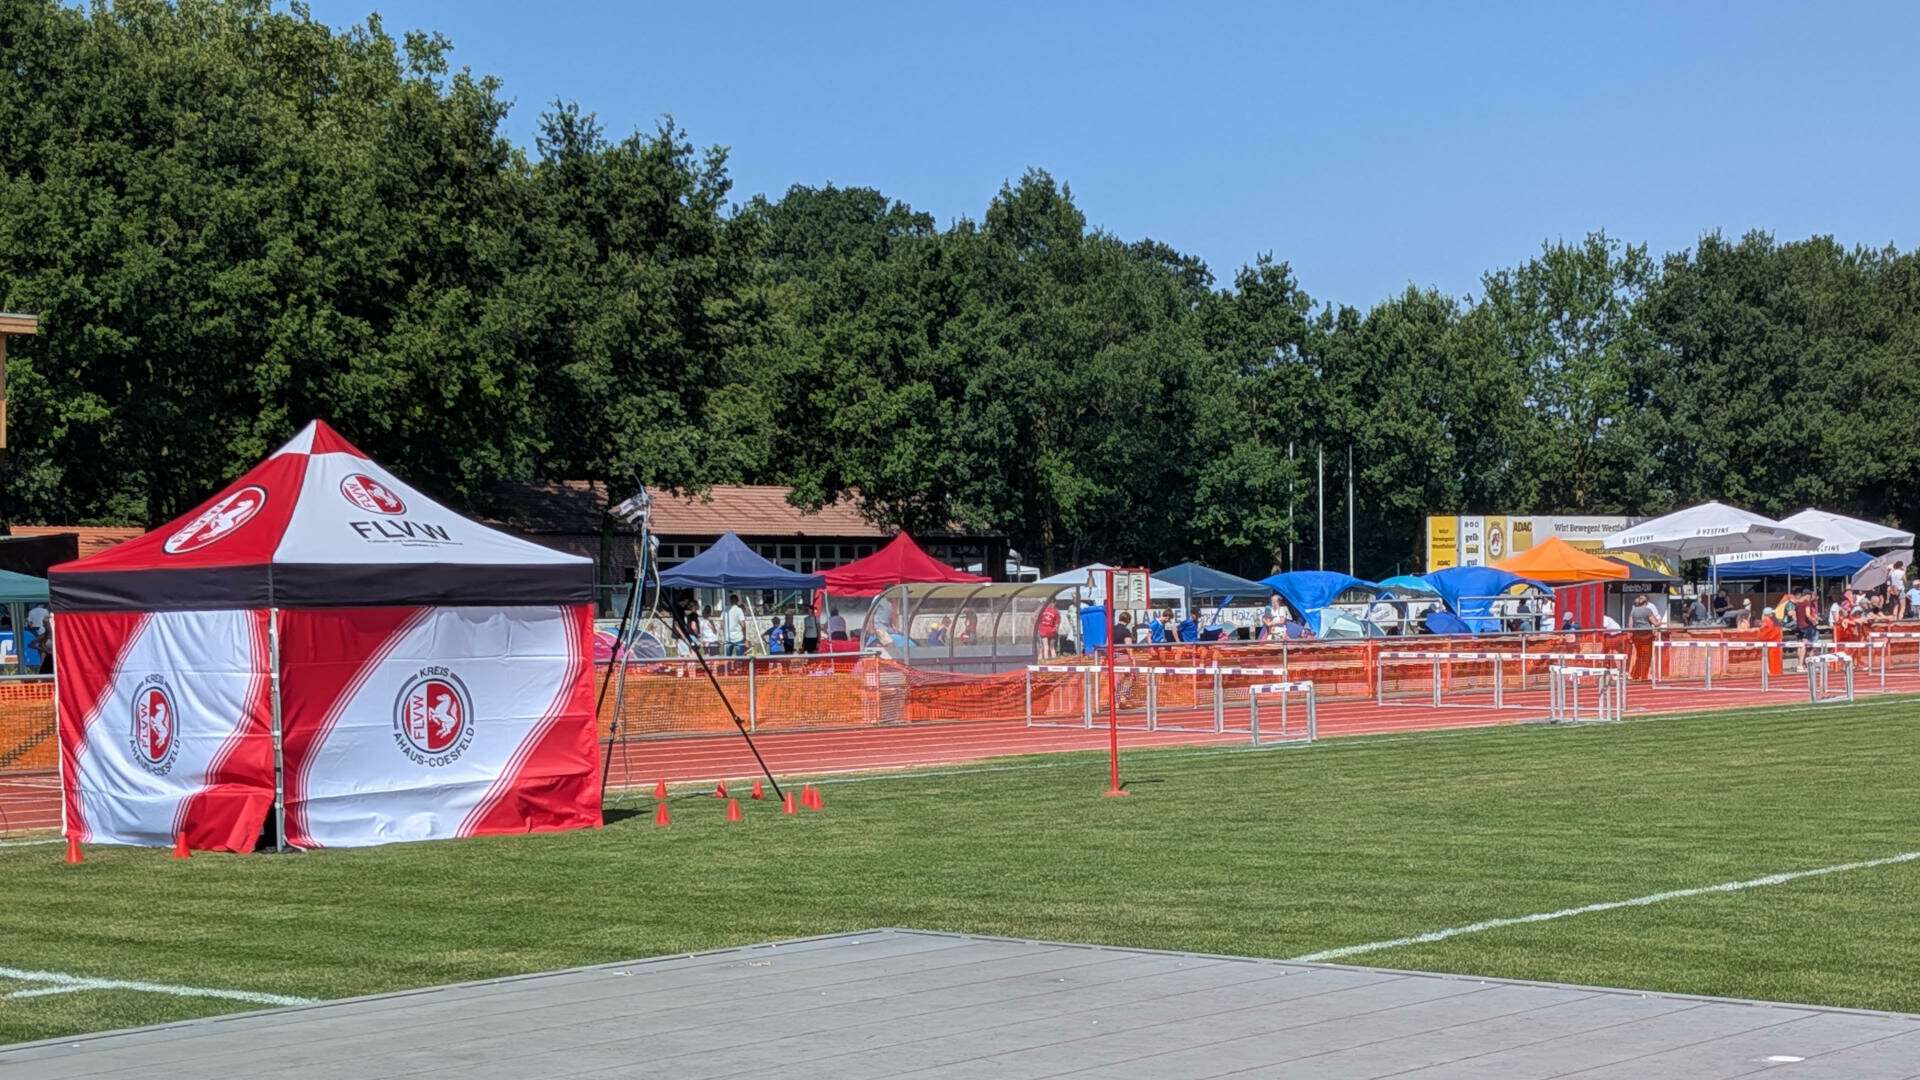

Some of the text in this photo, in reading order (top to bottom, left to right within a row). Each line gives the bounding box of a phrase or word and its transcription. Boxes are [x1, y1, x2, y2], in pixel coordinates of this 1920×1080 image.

[349, 520, 451, 541] FLVW
[1512, 521, 1533, 532] ADAC
[420, 666, 450, 678] KREIS
[140, 703, 149, 748] FLVW
[413, 695, 425, 740] FLVW
[393, 727, 475, 768] AHAUS-COESFELD
